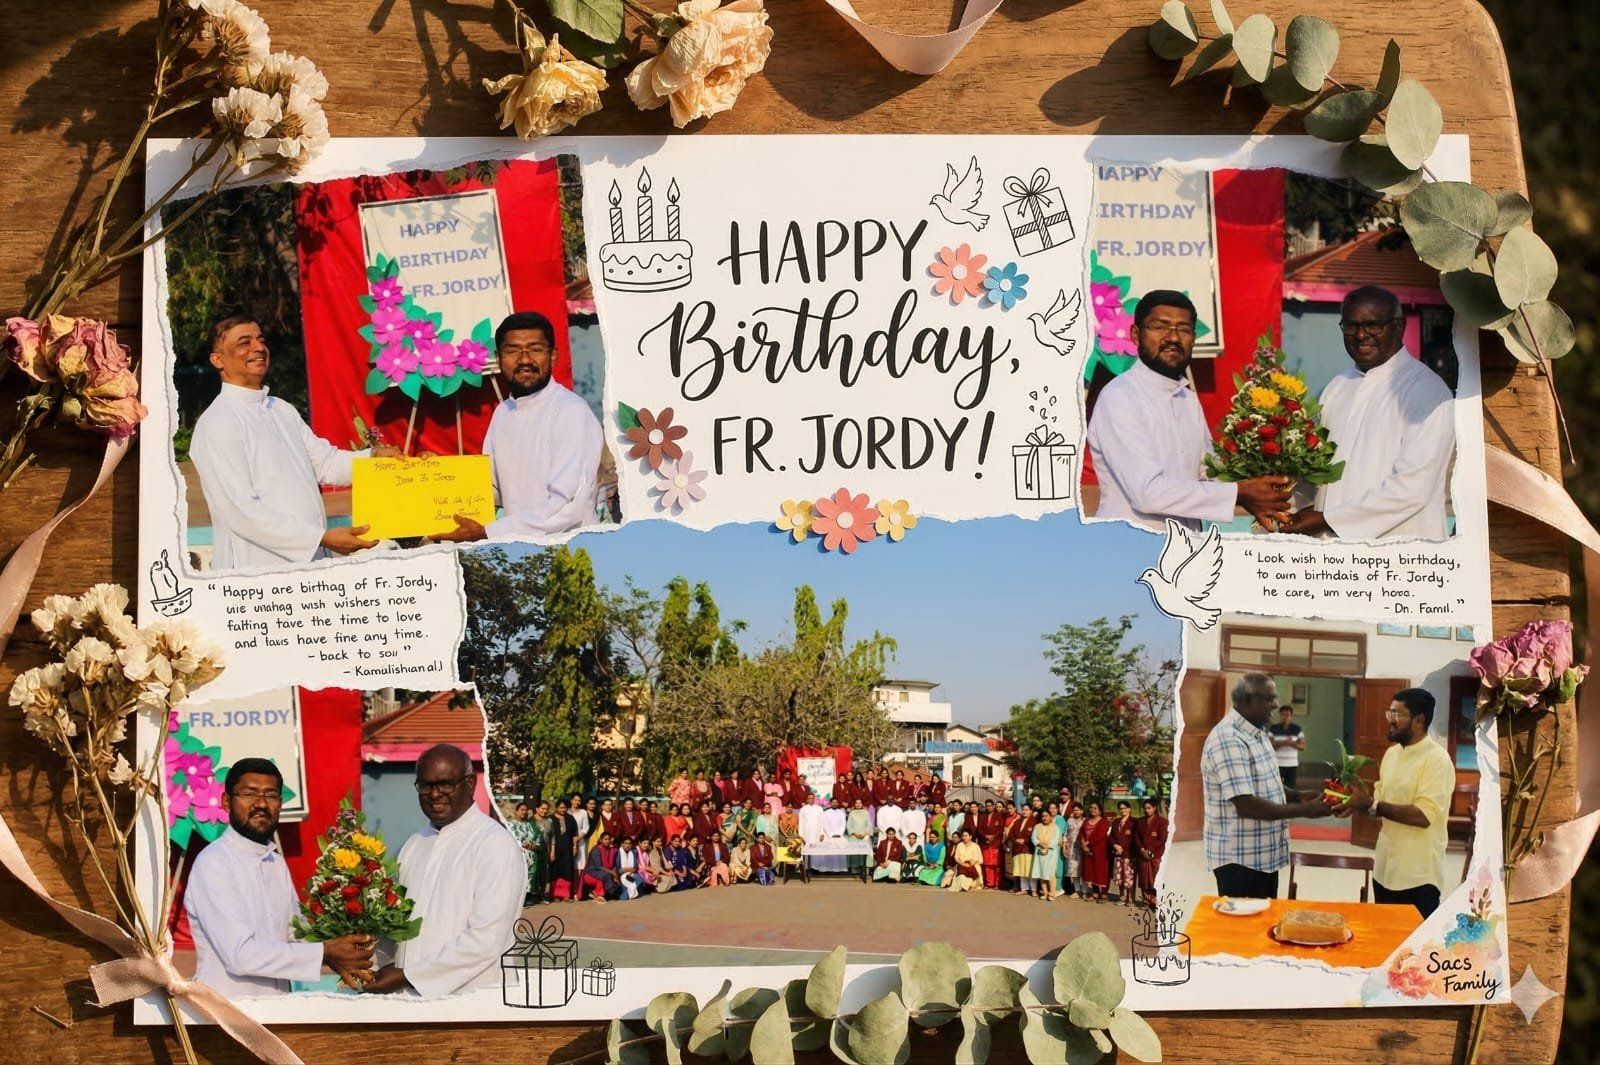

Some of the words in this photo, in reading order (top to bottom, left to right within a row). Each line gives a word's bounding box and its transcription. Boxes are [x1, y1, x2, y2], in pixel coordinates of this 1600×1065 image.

[1096, 202, 1196, 219] IRTHDAY
[399, 218, 460, 238] HAPPY
[399, 247, 489, 269] BIRTHDAY
[717, 219, 929, 285] HAPPY
[638, 288, 1021, 410] Birthday,
[713, 416, 787, 475] FR.
[798, 410, 996, 480] JORDY!
[1291, 552, 1316, 564] wish
[1323, 553, 1345, 564] how
[1352, 553, 1390, 569] happy
[1398, 553, 1461, 571] birthday,
[1256, 568, 1269, 579] to
[1304, 569, 1359, 581] birthdais
[1366, 570, 1380, 581] of
[271, 585, 294, 595] are
[354, 577, 368, 590] of
[1263, 586, 1279, 597] he
[1285, 589, 1315, 600] care,
[1345, 590, 1372, 602] very
[334, 597, 381, 609] wishers
[388, 596, 417, 606] nove
[311, 616, 333, 627] the
[340, 613, 370, 625] time
[376, 612, 390, 623] to
[396, 611, 423, 622] love
[234, 635, 258, 650] and
[296, 634, 328, 645] have
[364, 633, 388, 646] any
[319, 649, 350, 662] back
[357, 648, 371, 659] to
[1426, 951, 1472, 974] Sacs
[1442, 970, 1502, 1000] Family
